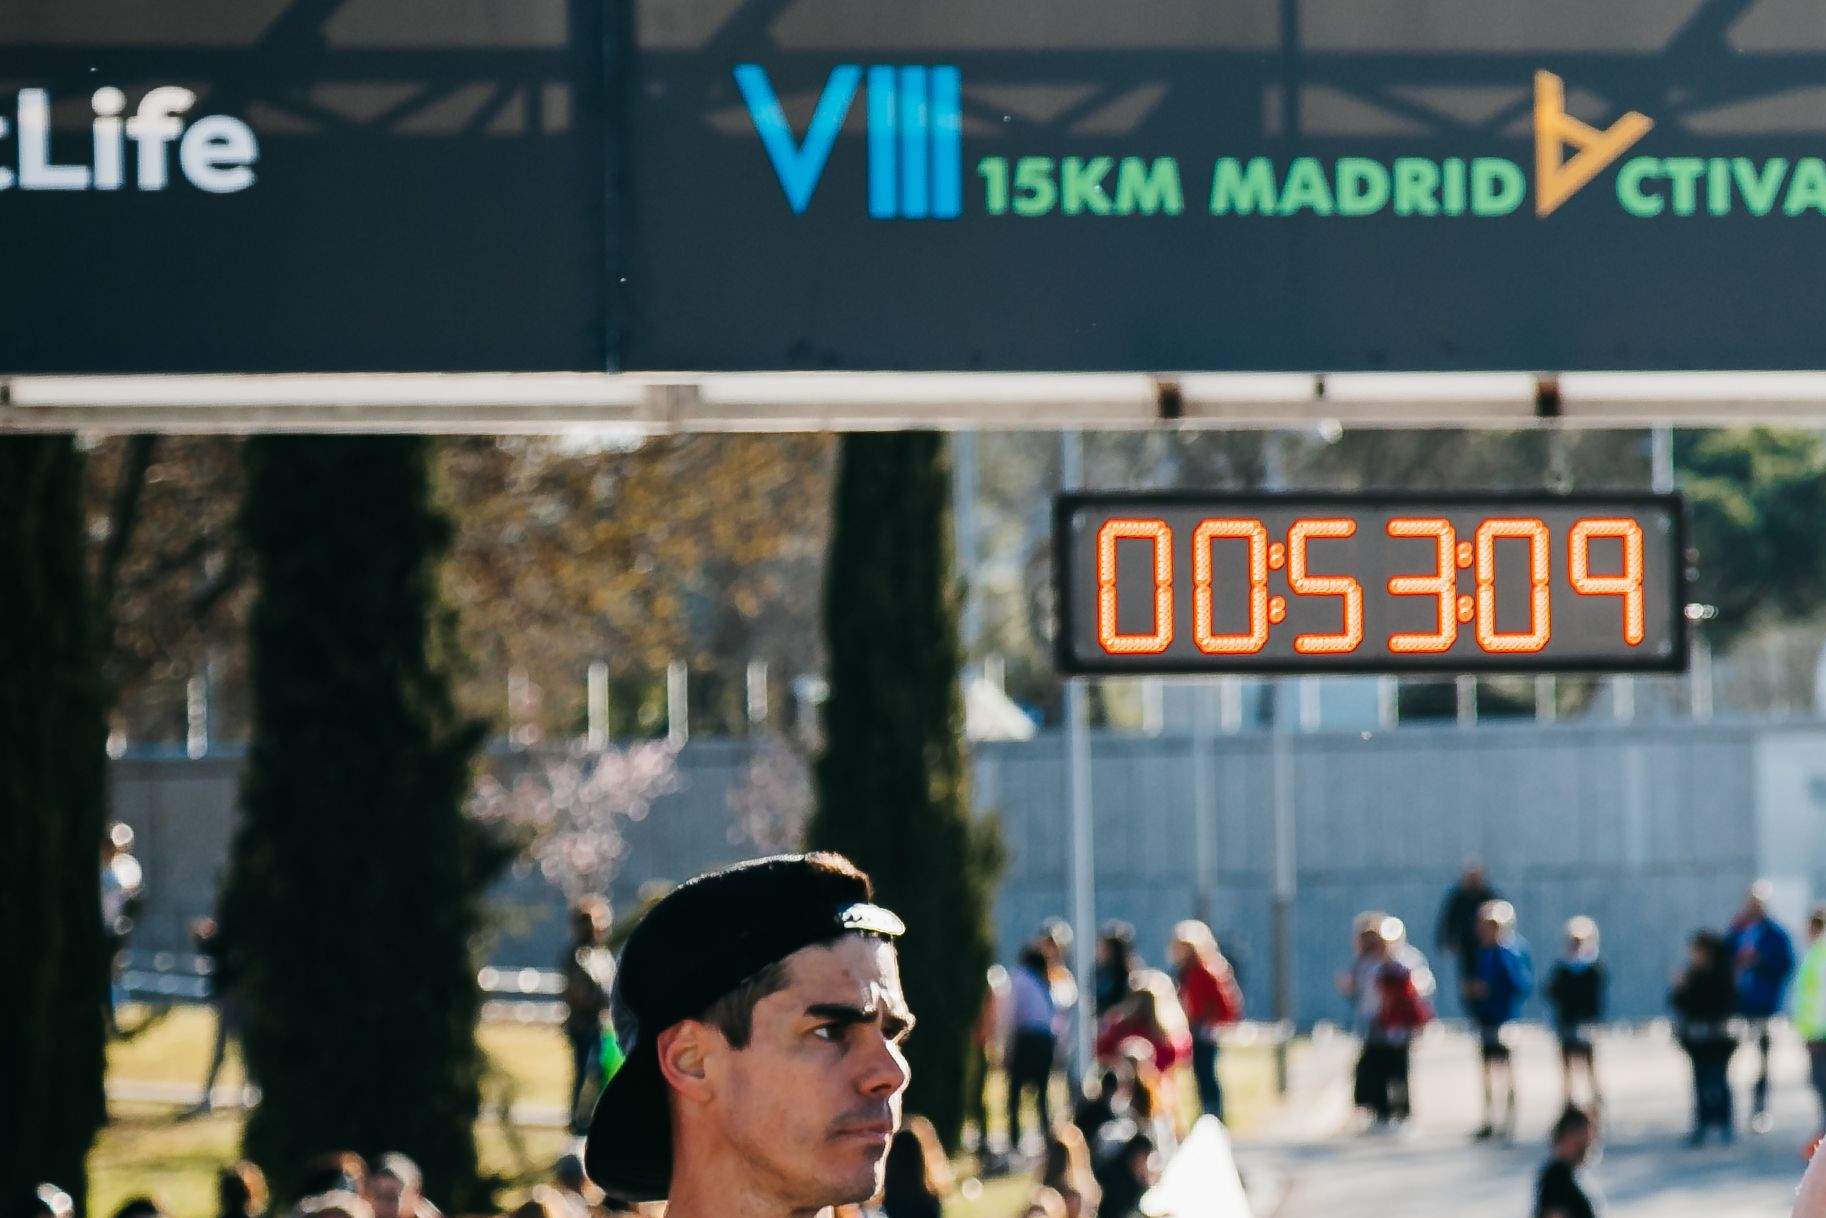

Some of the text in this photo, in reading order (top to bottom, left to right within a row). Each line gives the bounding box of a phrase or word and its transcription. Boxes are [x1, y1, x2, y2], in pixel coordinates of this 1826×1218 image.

[732, 63, 962, 220] VIII
[976, 156, 1184, 217] 15KM
[1209, 155, 1527, 218] MADRID
[1096, 517, 1646, 655] 00:53:09
